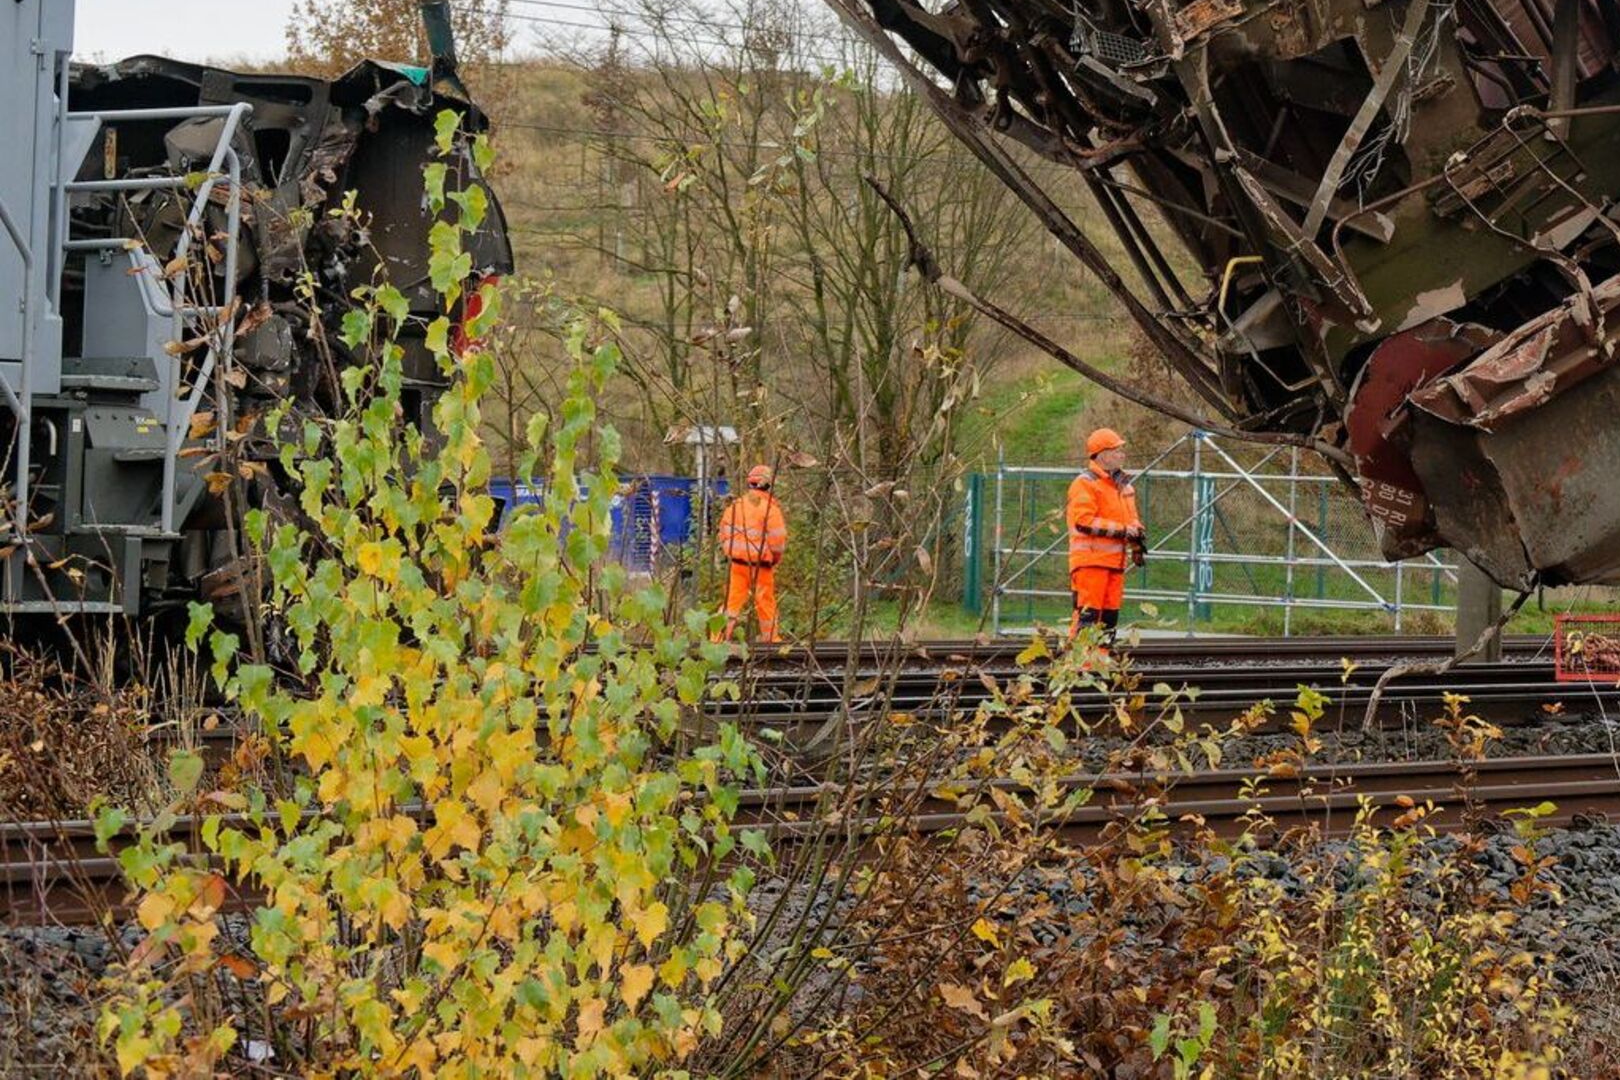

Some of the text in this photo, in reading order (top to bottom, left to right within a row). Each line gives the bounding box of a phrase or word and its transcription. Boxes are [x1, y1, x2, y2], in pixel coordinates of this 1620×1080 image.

[1378, 483, 1397, 501] 80
[1388, 489, 1414, 528] 31 RI
